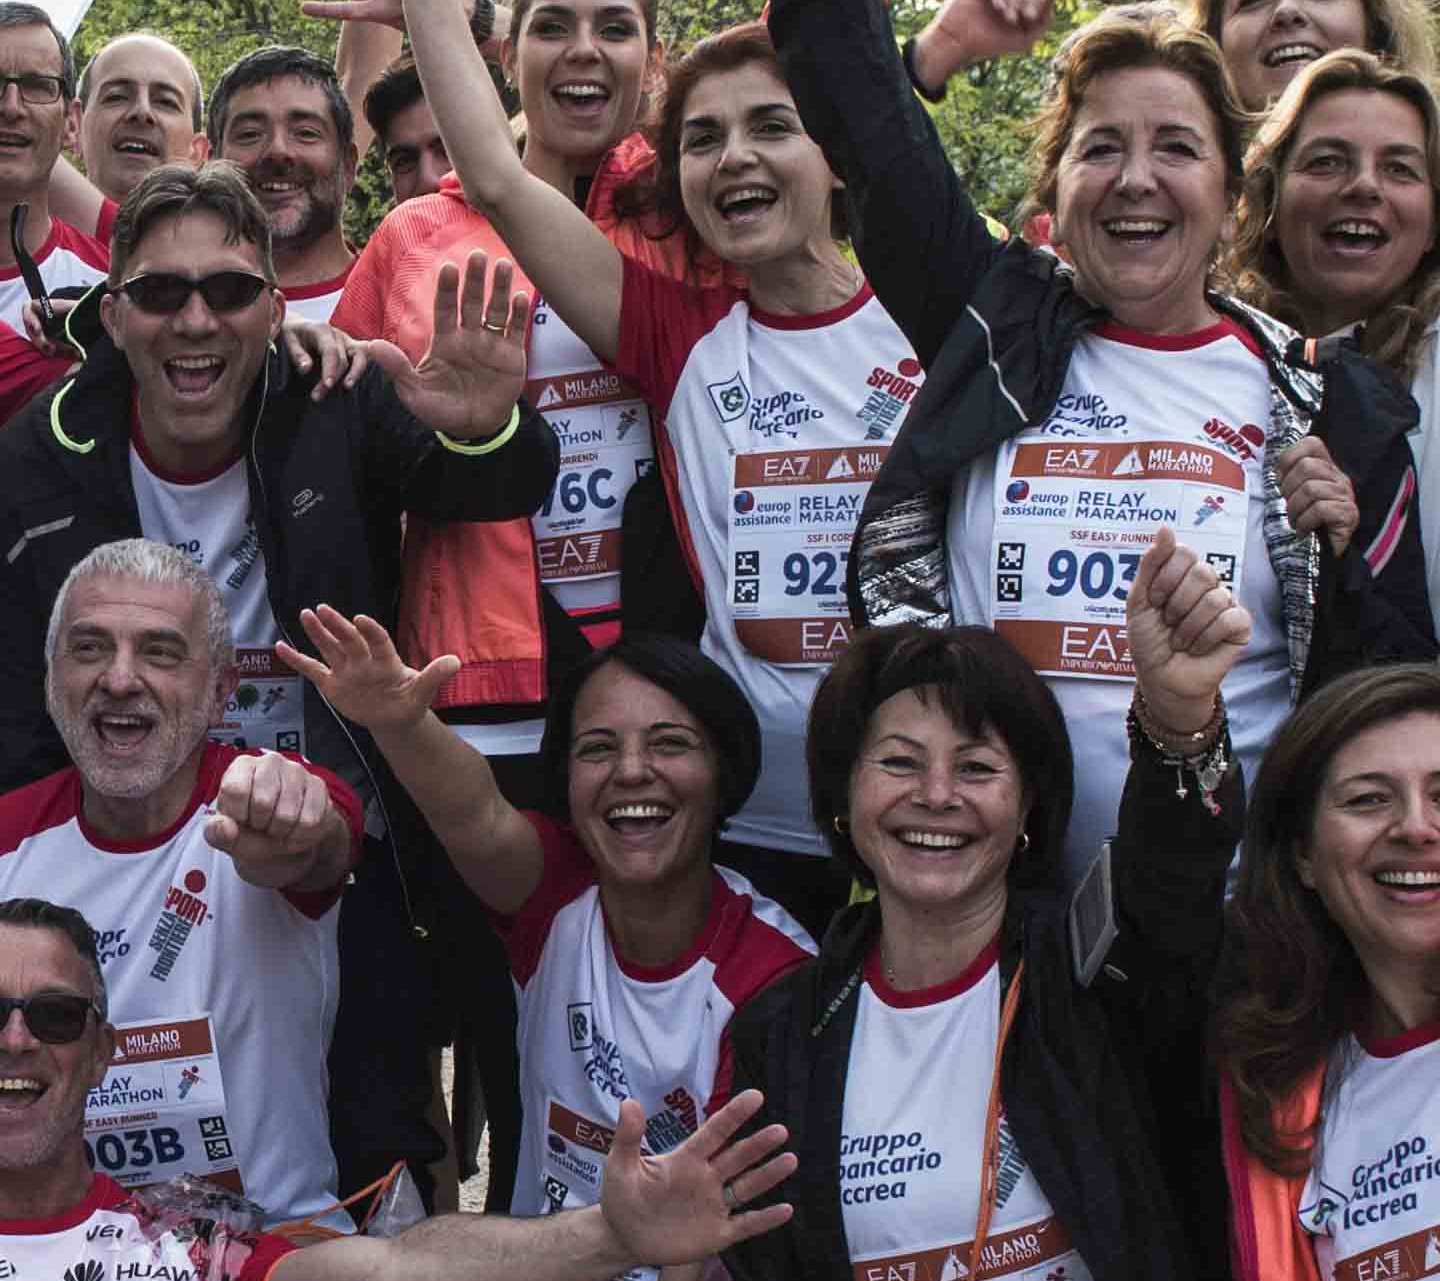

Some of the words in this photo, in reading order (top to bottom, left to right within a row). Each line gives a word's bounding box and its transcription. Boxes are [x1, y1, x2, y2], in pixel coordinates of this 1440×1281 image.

[563, 374, 619, 393] MILANO
[764, 456, 810, 477] EA7
[1045, 449, 1101, 469] EA7
[1148, 449, 1214, 468] MILANO
[1148, 462, 1213, 475] MARATHON
[800, 495, 860, 510] RELAY
[1030, 493, 1069, 506] europ
[1078, 491, 1146, 507] RELAY
[757, 501, 791, 515] europ
[1002, 505, 1066, 518] assistance
[1075, 506, 1177, 522] MARATHON
[734, 514, 792, 527] assistance
[1070, 530, 1089, 540] SSF
[1091, 531, 1118, 542] EASY
[1120, 533, 1156, 543] RUNNE
[148, 911, 177, 952] SENZA
[126, 1028, 180, 1050] MILANO
[127, 1041, 181, 1056] MARATHON
[1344, 1193, 1418, 1230] Iccrea
